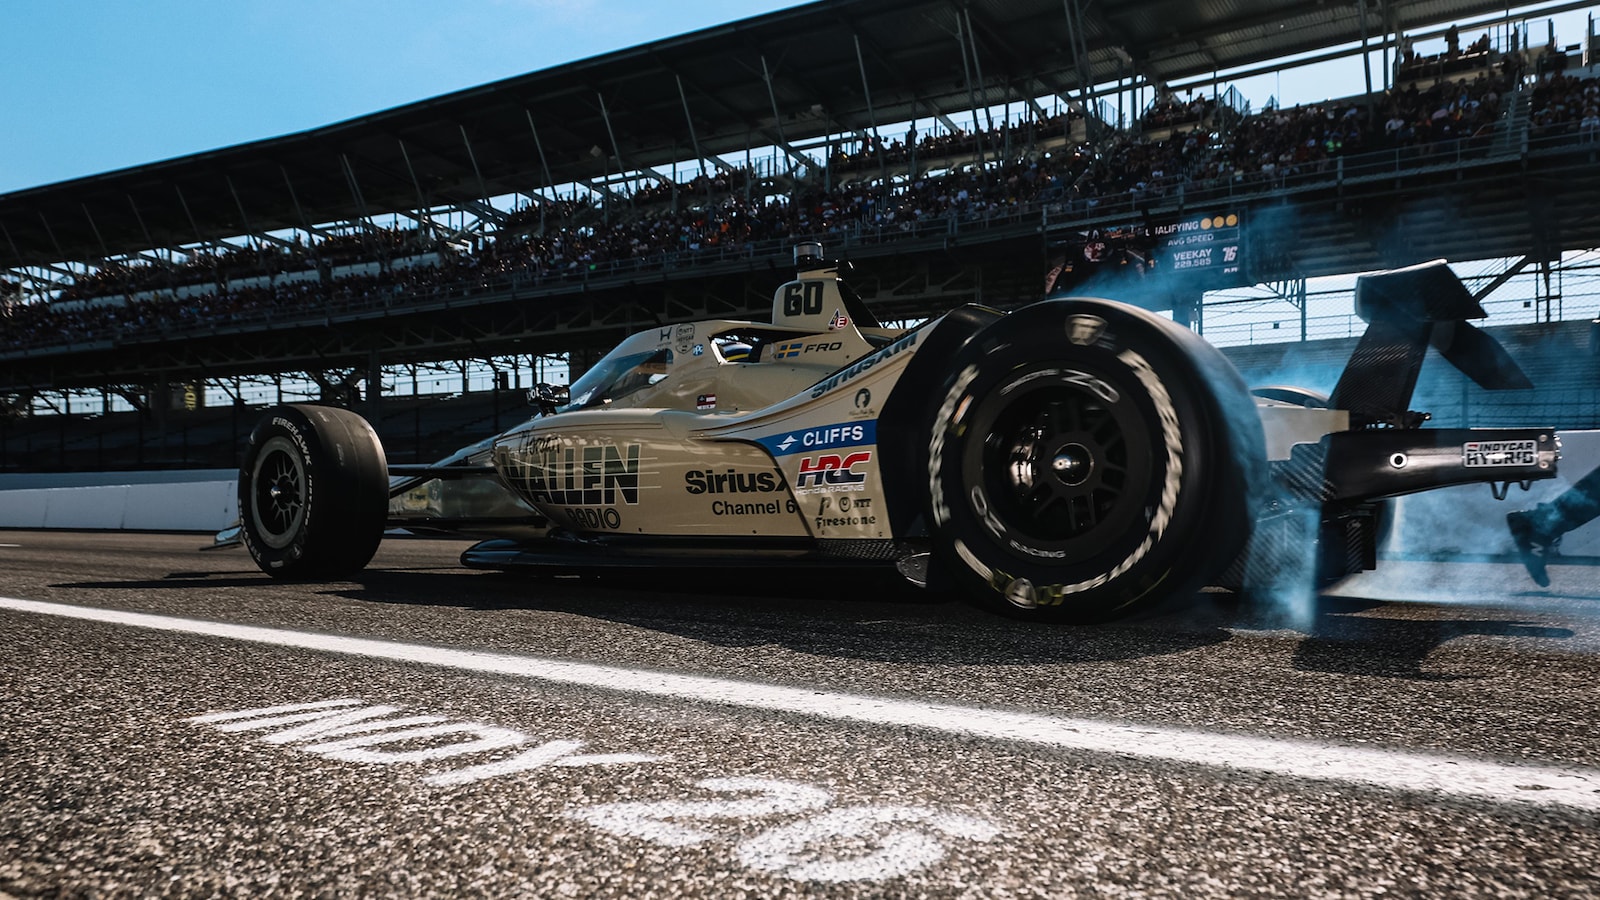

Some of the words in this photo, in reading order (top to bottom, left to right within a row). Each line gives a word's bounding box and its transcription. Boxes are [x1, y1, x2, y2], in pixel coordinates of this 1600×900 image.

[1186, 233, 1214, 244] SPEED
[1173, 248, 1213, 261] VEEKAY
[783, 281, 824, 317] 60
[804, 342, 842, 353] FRO
[272, 416, 312, 466] FIREHAWK
[802, 425, 864, 446] CLIFFS
[1480, 442, 1534, 452] INDYCAR
[496, 443, 642, 505] WALLEN
[796, 451, 872, 489] HRC
[828, 484, 865, 493] RACING
[712, 500, 780, 515] Channel
[815, 515, 876, 529] Firestone
[190, 697, 668, 788] INDY
